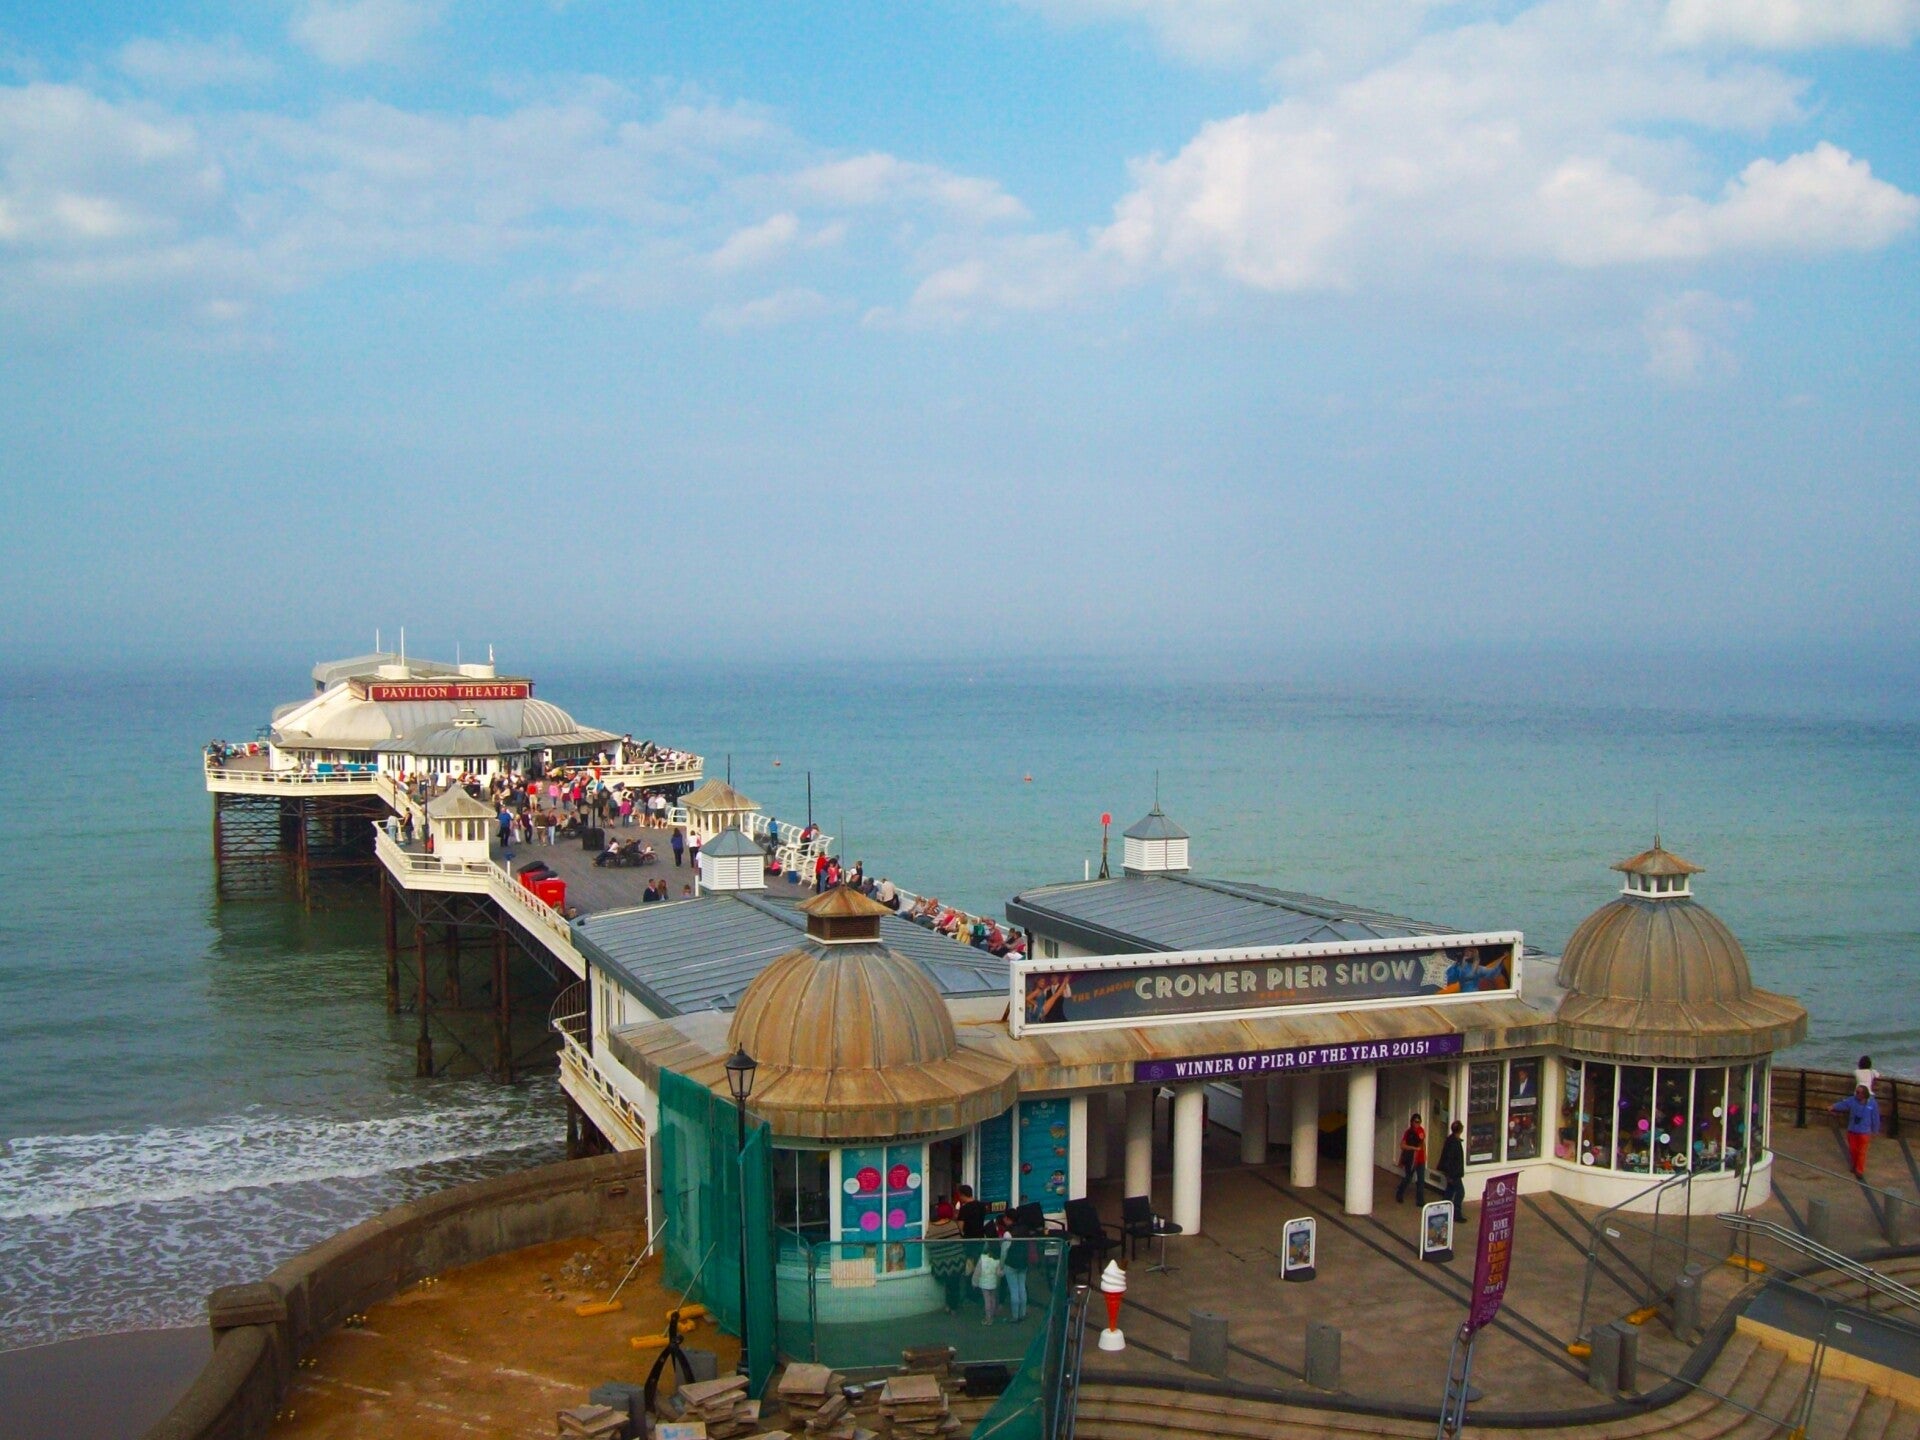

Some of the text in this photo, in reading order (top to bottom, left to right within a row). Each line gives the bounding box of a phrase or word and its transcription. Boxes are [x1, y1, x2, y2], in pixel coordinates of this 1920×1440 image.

[382, 686, 517, 698] PAVILION THEATRE
[1135, 970, 1257, 1000] CROMER
[1267, 965, 1327, 991] PIER
[1335, 959, 1416, 985] SHOW
[1175, 1058, 1234, 1076] WINNER
[1238, 1056, 1256, 1070] OF
[1260, 1053, 1295, 1069] PIER
[1298, 1050, 1317, 1065] OF
[1320, 1048, 1347, 1063] THE
[1351, 1044, 1389, 1060] YEAR
[1392, 1041, 1430, 1056] 2015!
